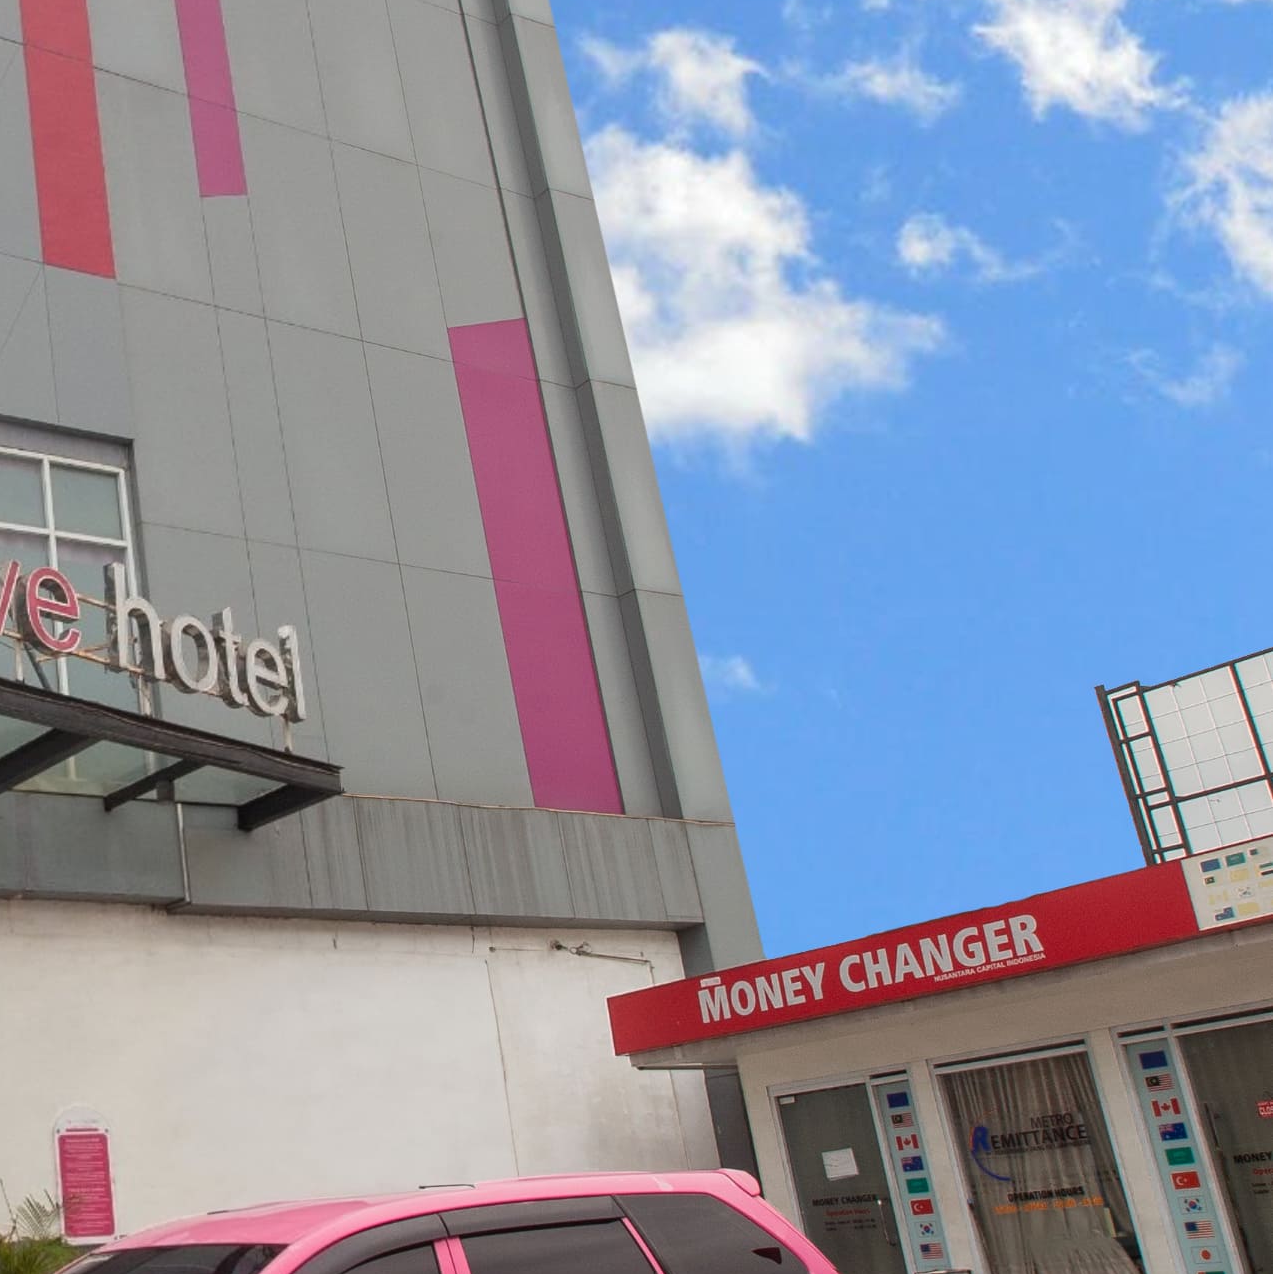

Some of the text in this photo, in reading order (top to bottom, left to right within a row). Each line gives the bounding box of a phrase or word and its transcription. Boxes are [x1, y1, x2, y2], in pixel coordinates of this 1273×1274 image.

[104, 561, 306, 722] hotel
[697, 914, 1045, 1025] MONEY CHANGER
[933, 952, 1047, 983] NUSANTARA CAPITAL INDONESIA
[1030, 1113, 1074, 1129] METRO
[972, 1124, 1088, 1152] REMITTANCE
[1233, 1151, 1272, 1165] MONEY
